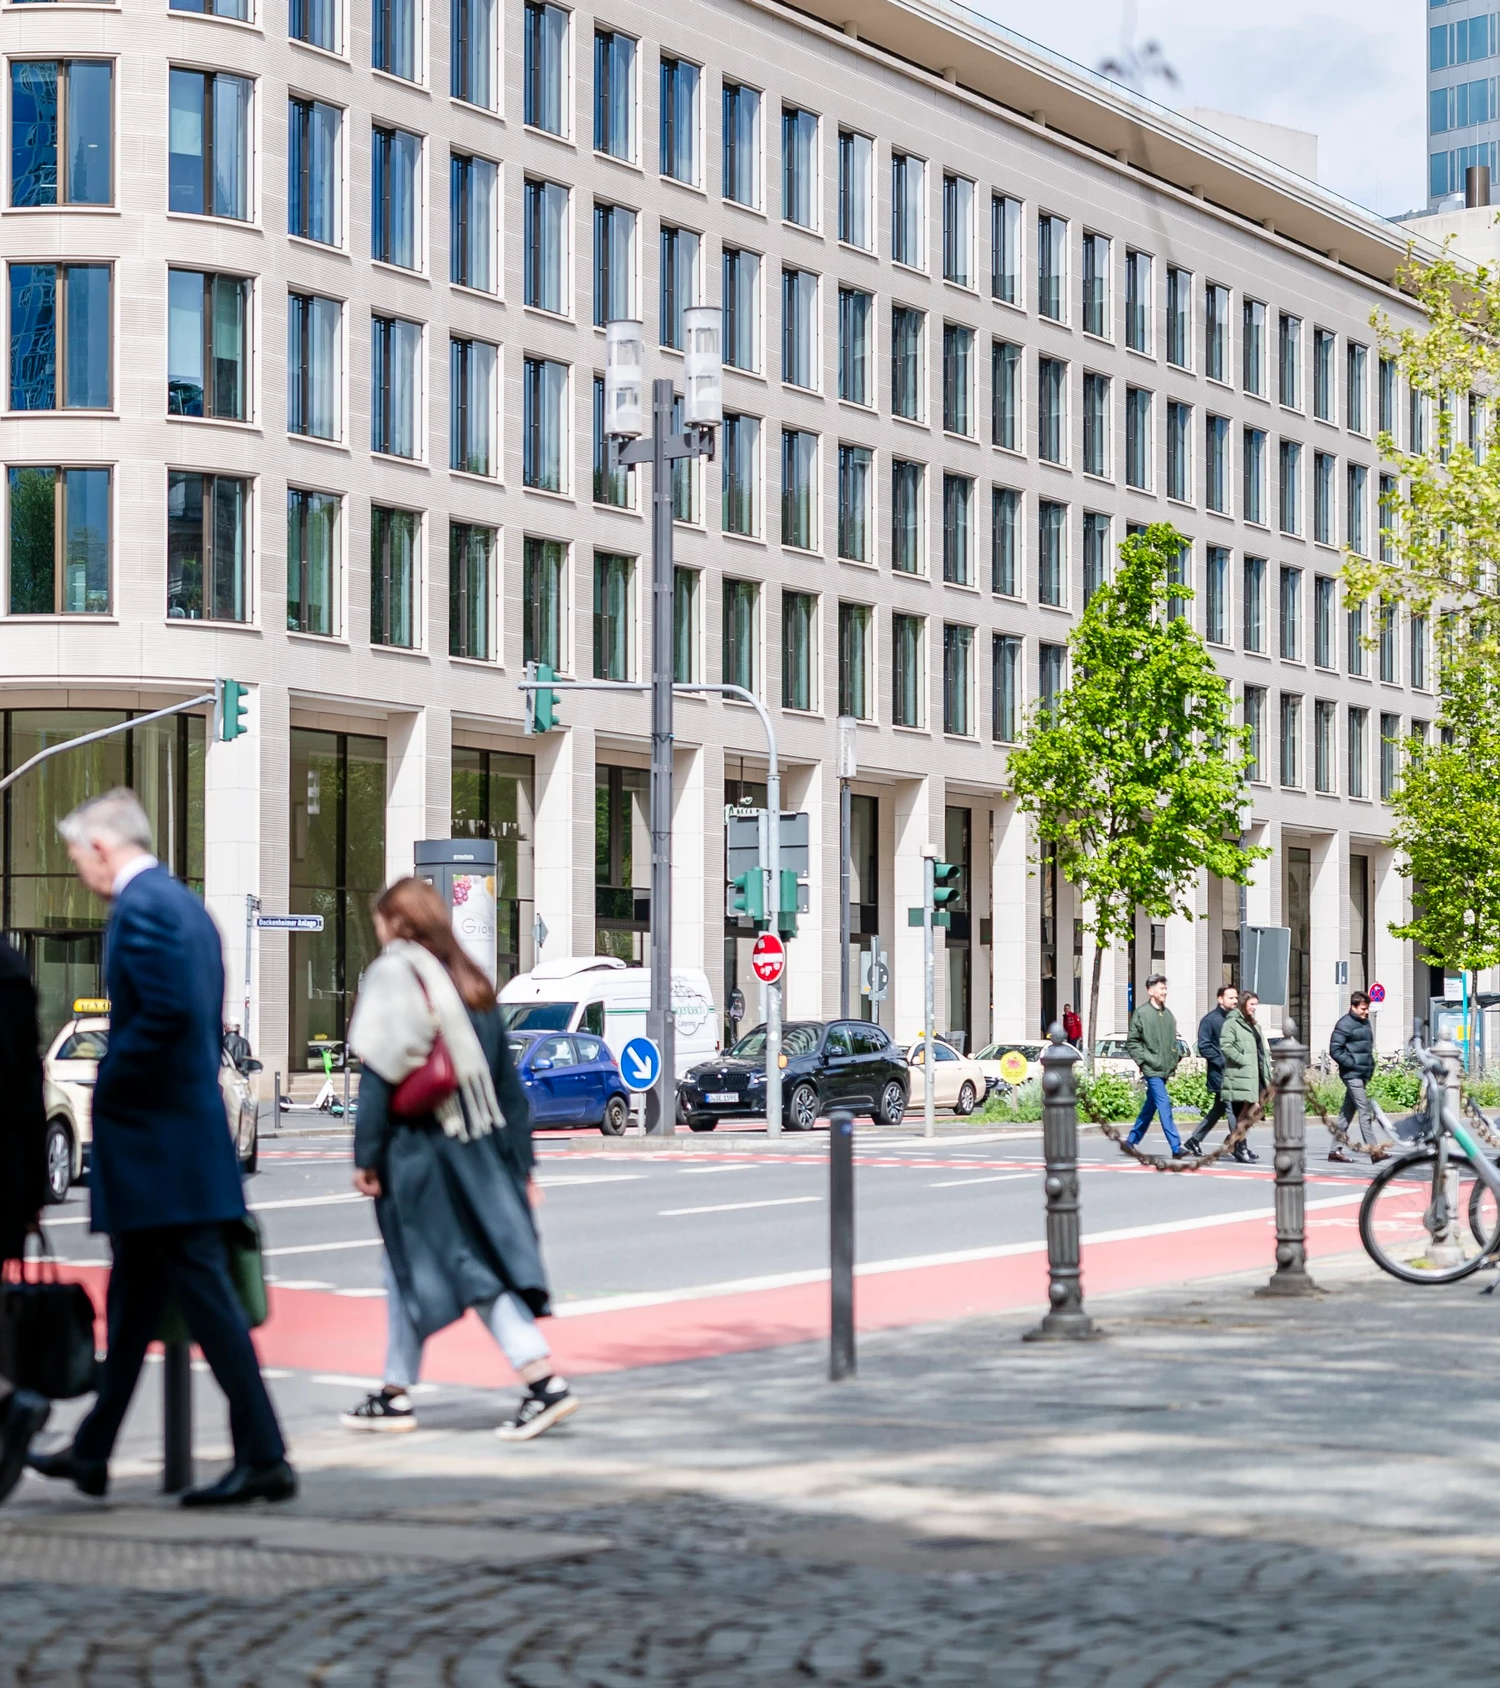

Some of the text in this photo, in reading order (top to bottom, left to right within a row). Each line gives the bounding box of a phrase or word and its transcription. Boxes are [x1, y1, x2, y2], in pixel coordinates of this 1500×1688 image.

[259, 919, 317, 929] Bockenheimer Anlage
[672, 1002, 705, 1017] agenbach
